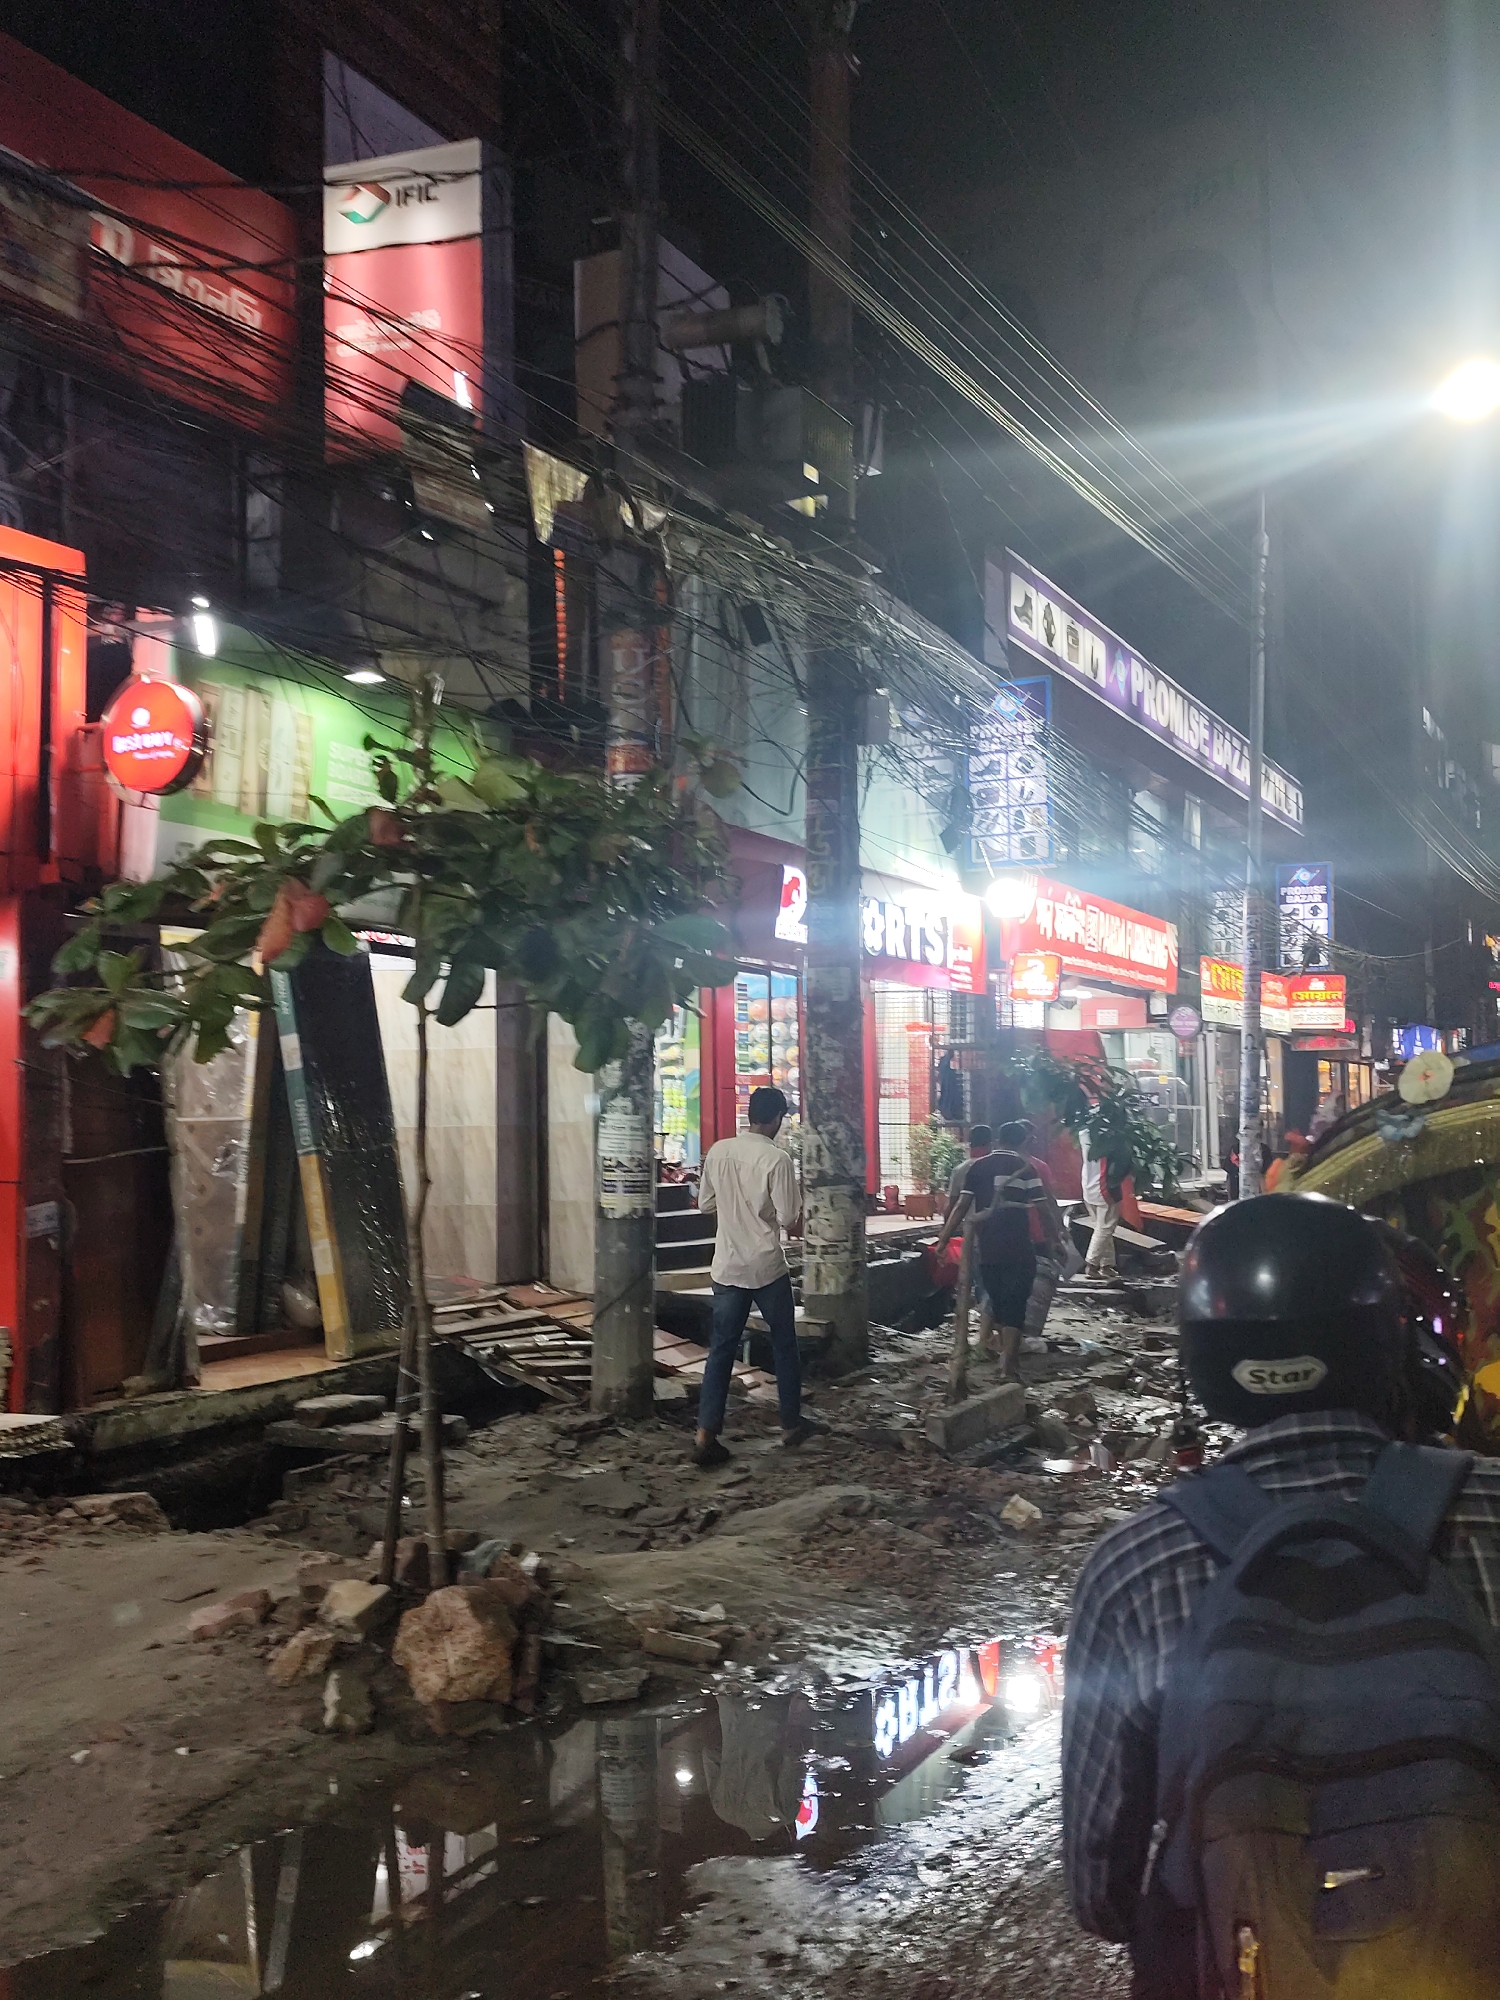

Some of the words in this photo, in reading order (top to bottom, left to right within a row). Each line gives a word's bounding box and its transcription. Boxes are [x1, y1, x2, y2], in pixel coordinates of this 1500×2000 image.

[1130, 657, 1210, 758] PROMISE
[1212, 722, 1251, 787] BAZA
[1280, 885, 1327, 896] PROMISE
[1285, 894, 1323, 903] BAZAR
[1248, 1367, 1318, 1385] Star
